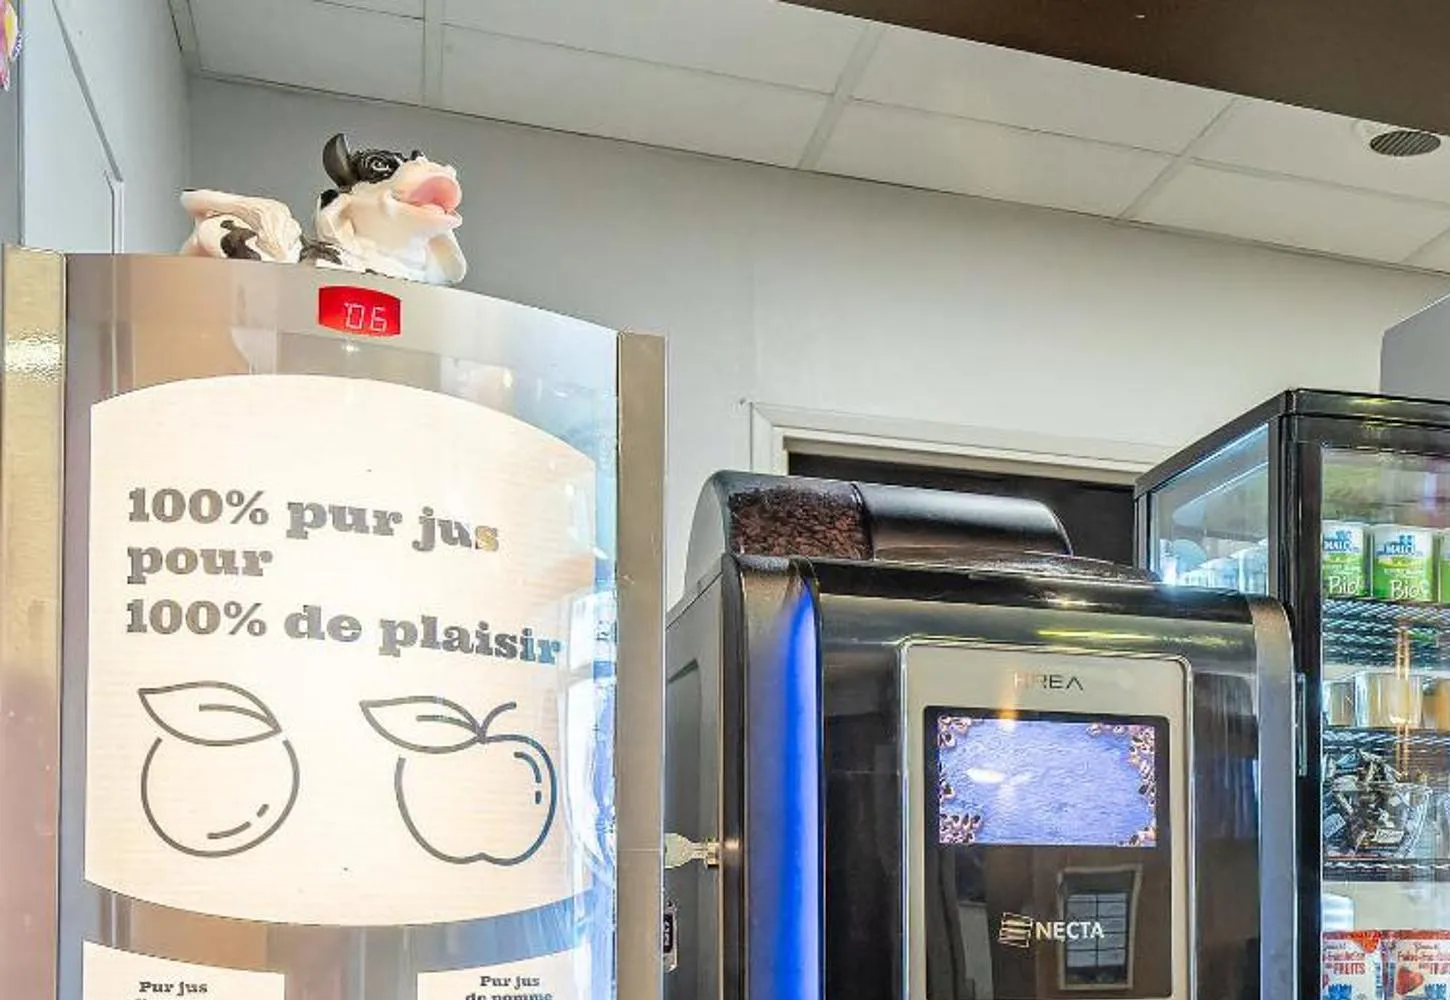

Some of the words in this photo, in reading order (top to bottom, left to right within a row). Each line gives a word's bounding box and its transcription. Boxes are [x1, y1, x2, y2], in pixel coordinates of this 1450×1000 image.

[128, 487, 269, 525] 100%
[285, 501, 403, 540] pur
[412, 506, 500, 552] jus
[126, 546, 274, 585] pour
[126, 598, 267, 637] 100%
[284, 604, 362, 642] de
[378, 614, 561, 666] plaisir
[1035, 921, 1105, 940] NECTA
[138, 981, 175, 993] Pur
[177, 981, 208, 996] jus
[480, 975, 512, 987] Pur
[514, 976, 541, 990] jus
